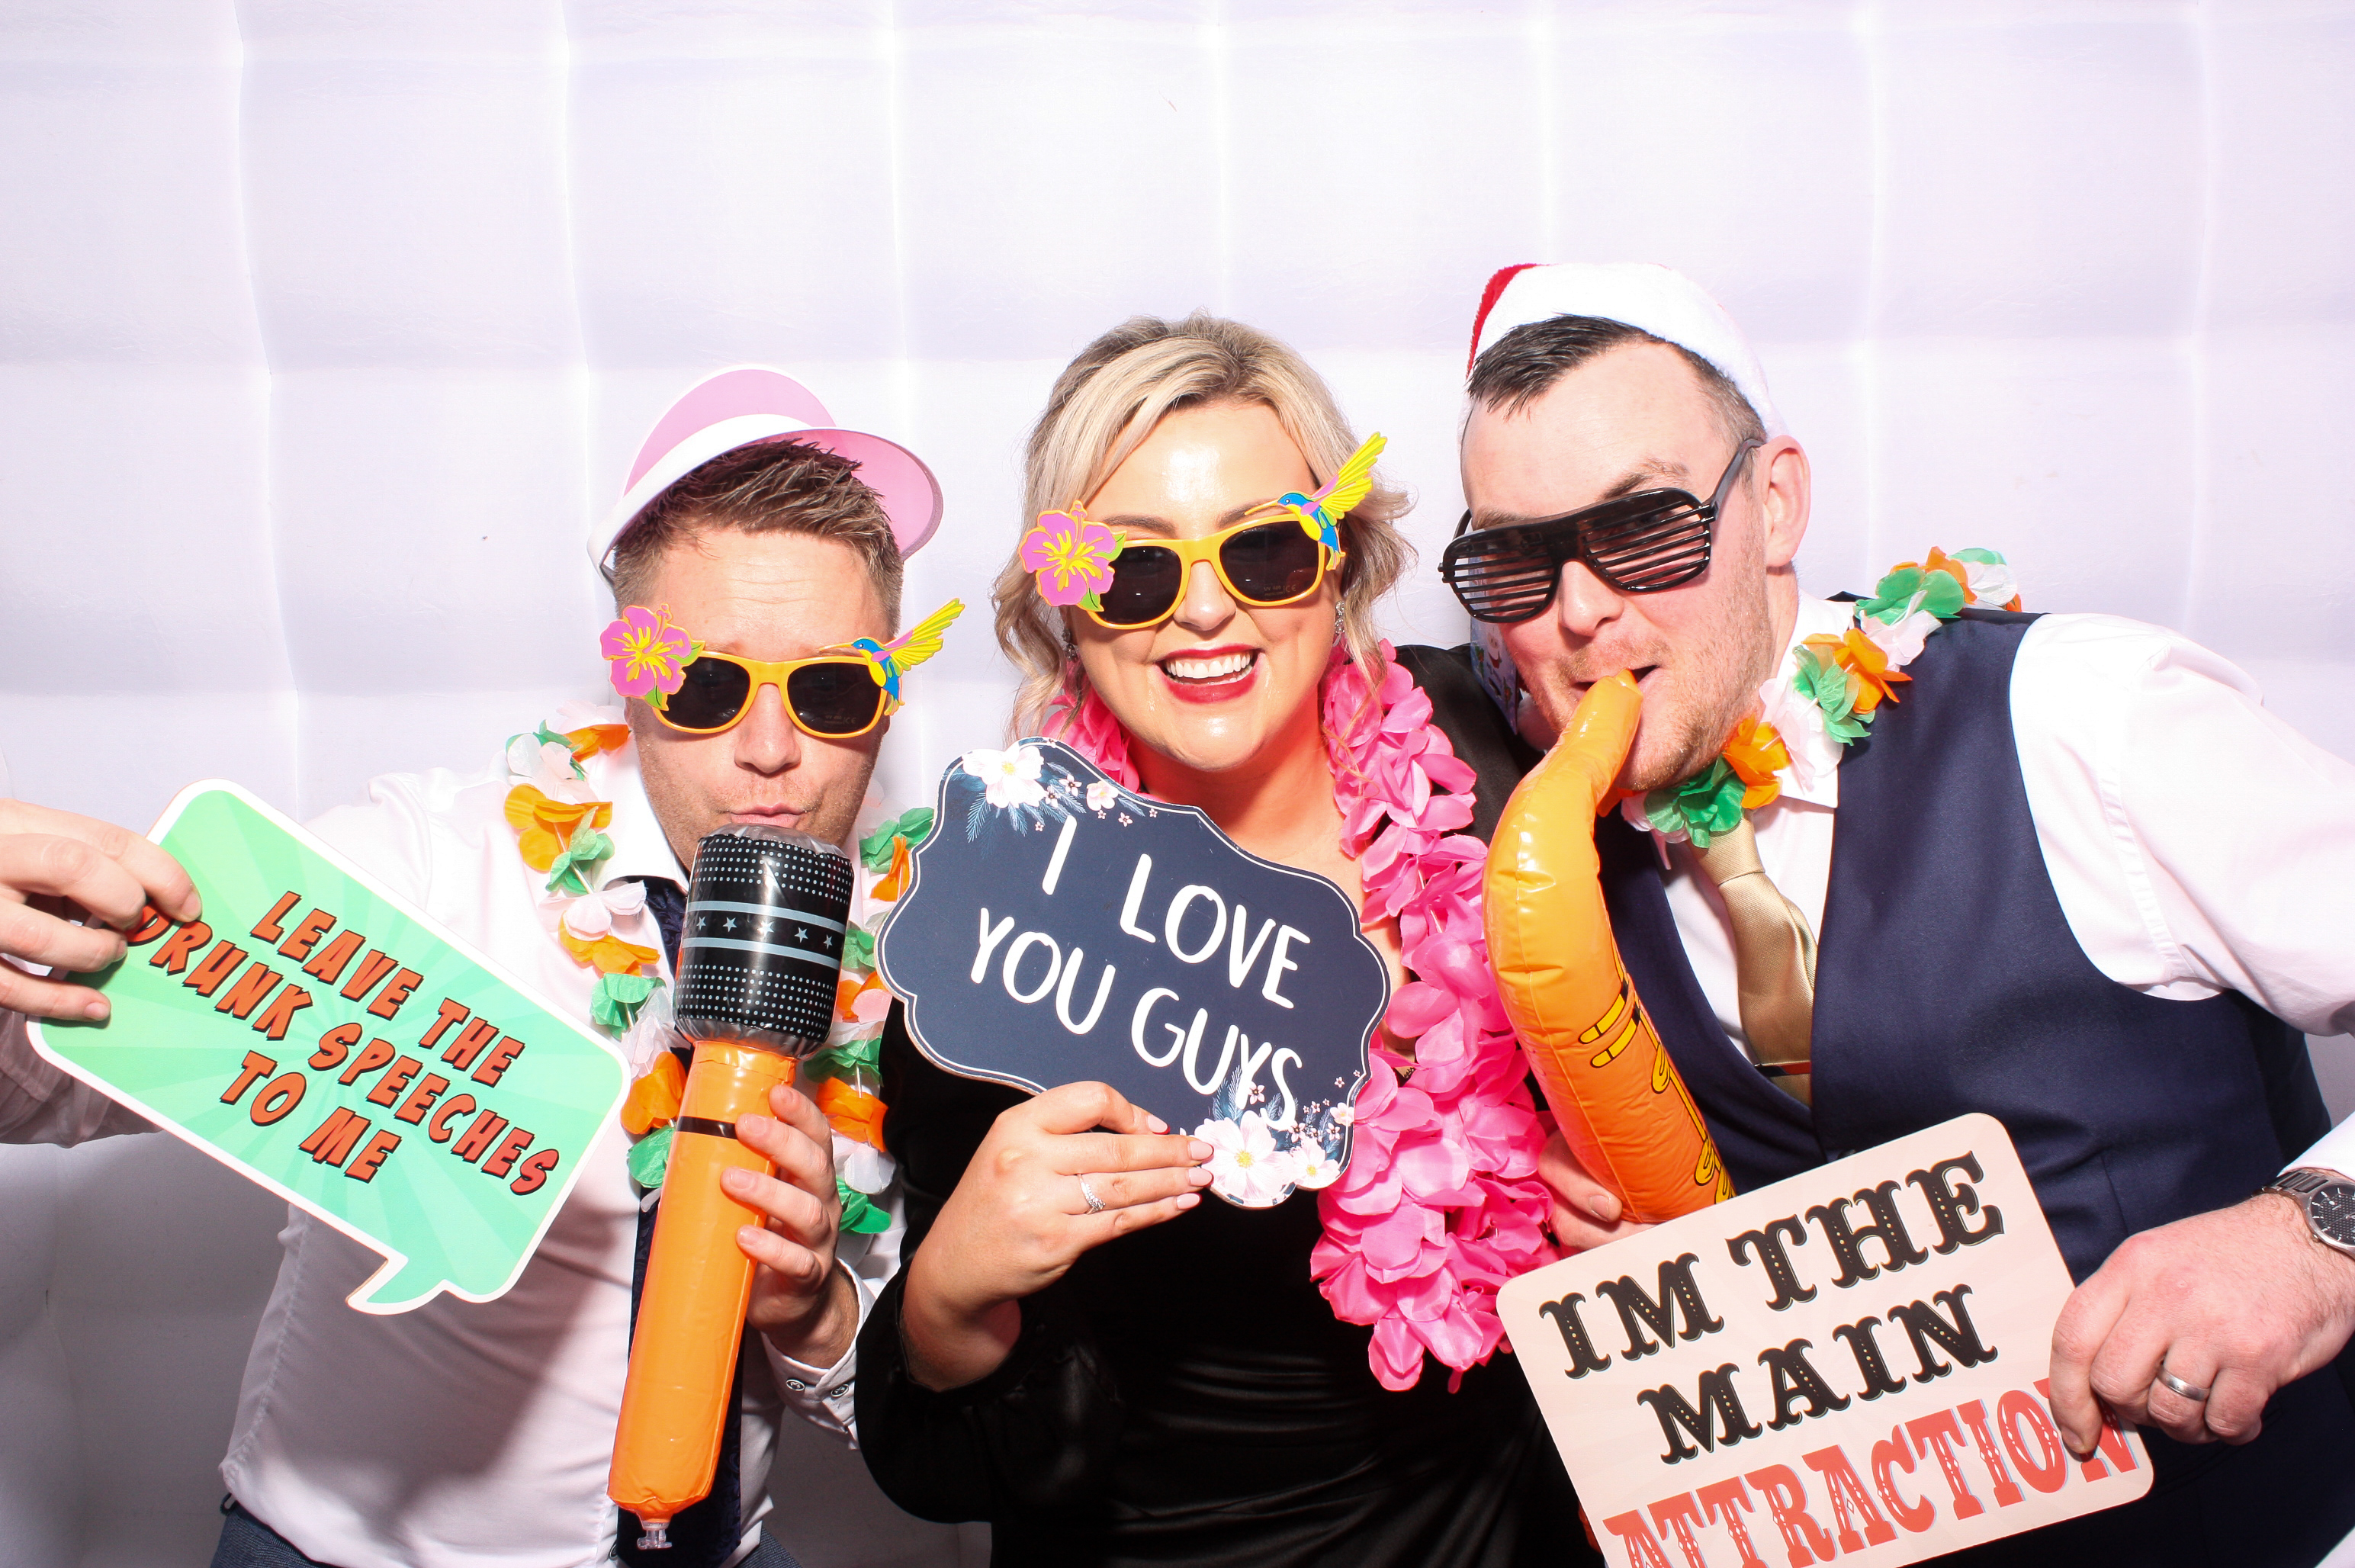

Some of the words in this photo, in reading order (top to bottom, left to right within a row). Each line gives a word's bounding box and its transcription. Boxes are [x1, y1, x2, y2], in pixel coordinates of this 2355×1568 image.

[249, 890, 425, 1020] LEAVE
[418, 997, 525, 1088] THE
[1042, 815, 1077, 895] I
[1120, 853, 1311, 1009] LOVE
[125, 903, 313, 1041] DRUNK
[307, 1022, 560, 1196] SPEECHES
[220, 1050, 307, 1126] TO
[298, 1106, 403, 1184] ME
[970, 908, 1116, 1035] YOU
[1131, 987, 1303, 1132] GUYS
[1538, 1252, 1724, 1380] IM
[1725, 1150, 2005, 1311] THE
[1637, 1284, 1999, 1465] MAIN
